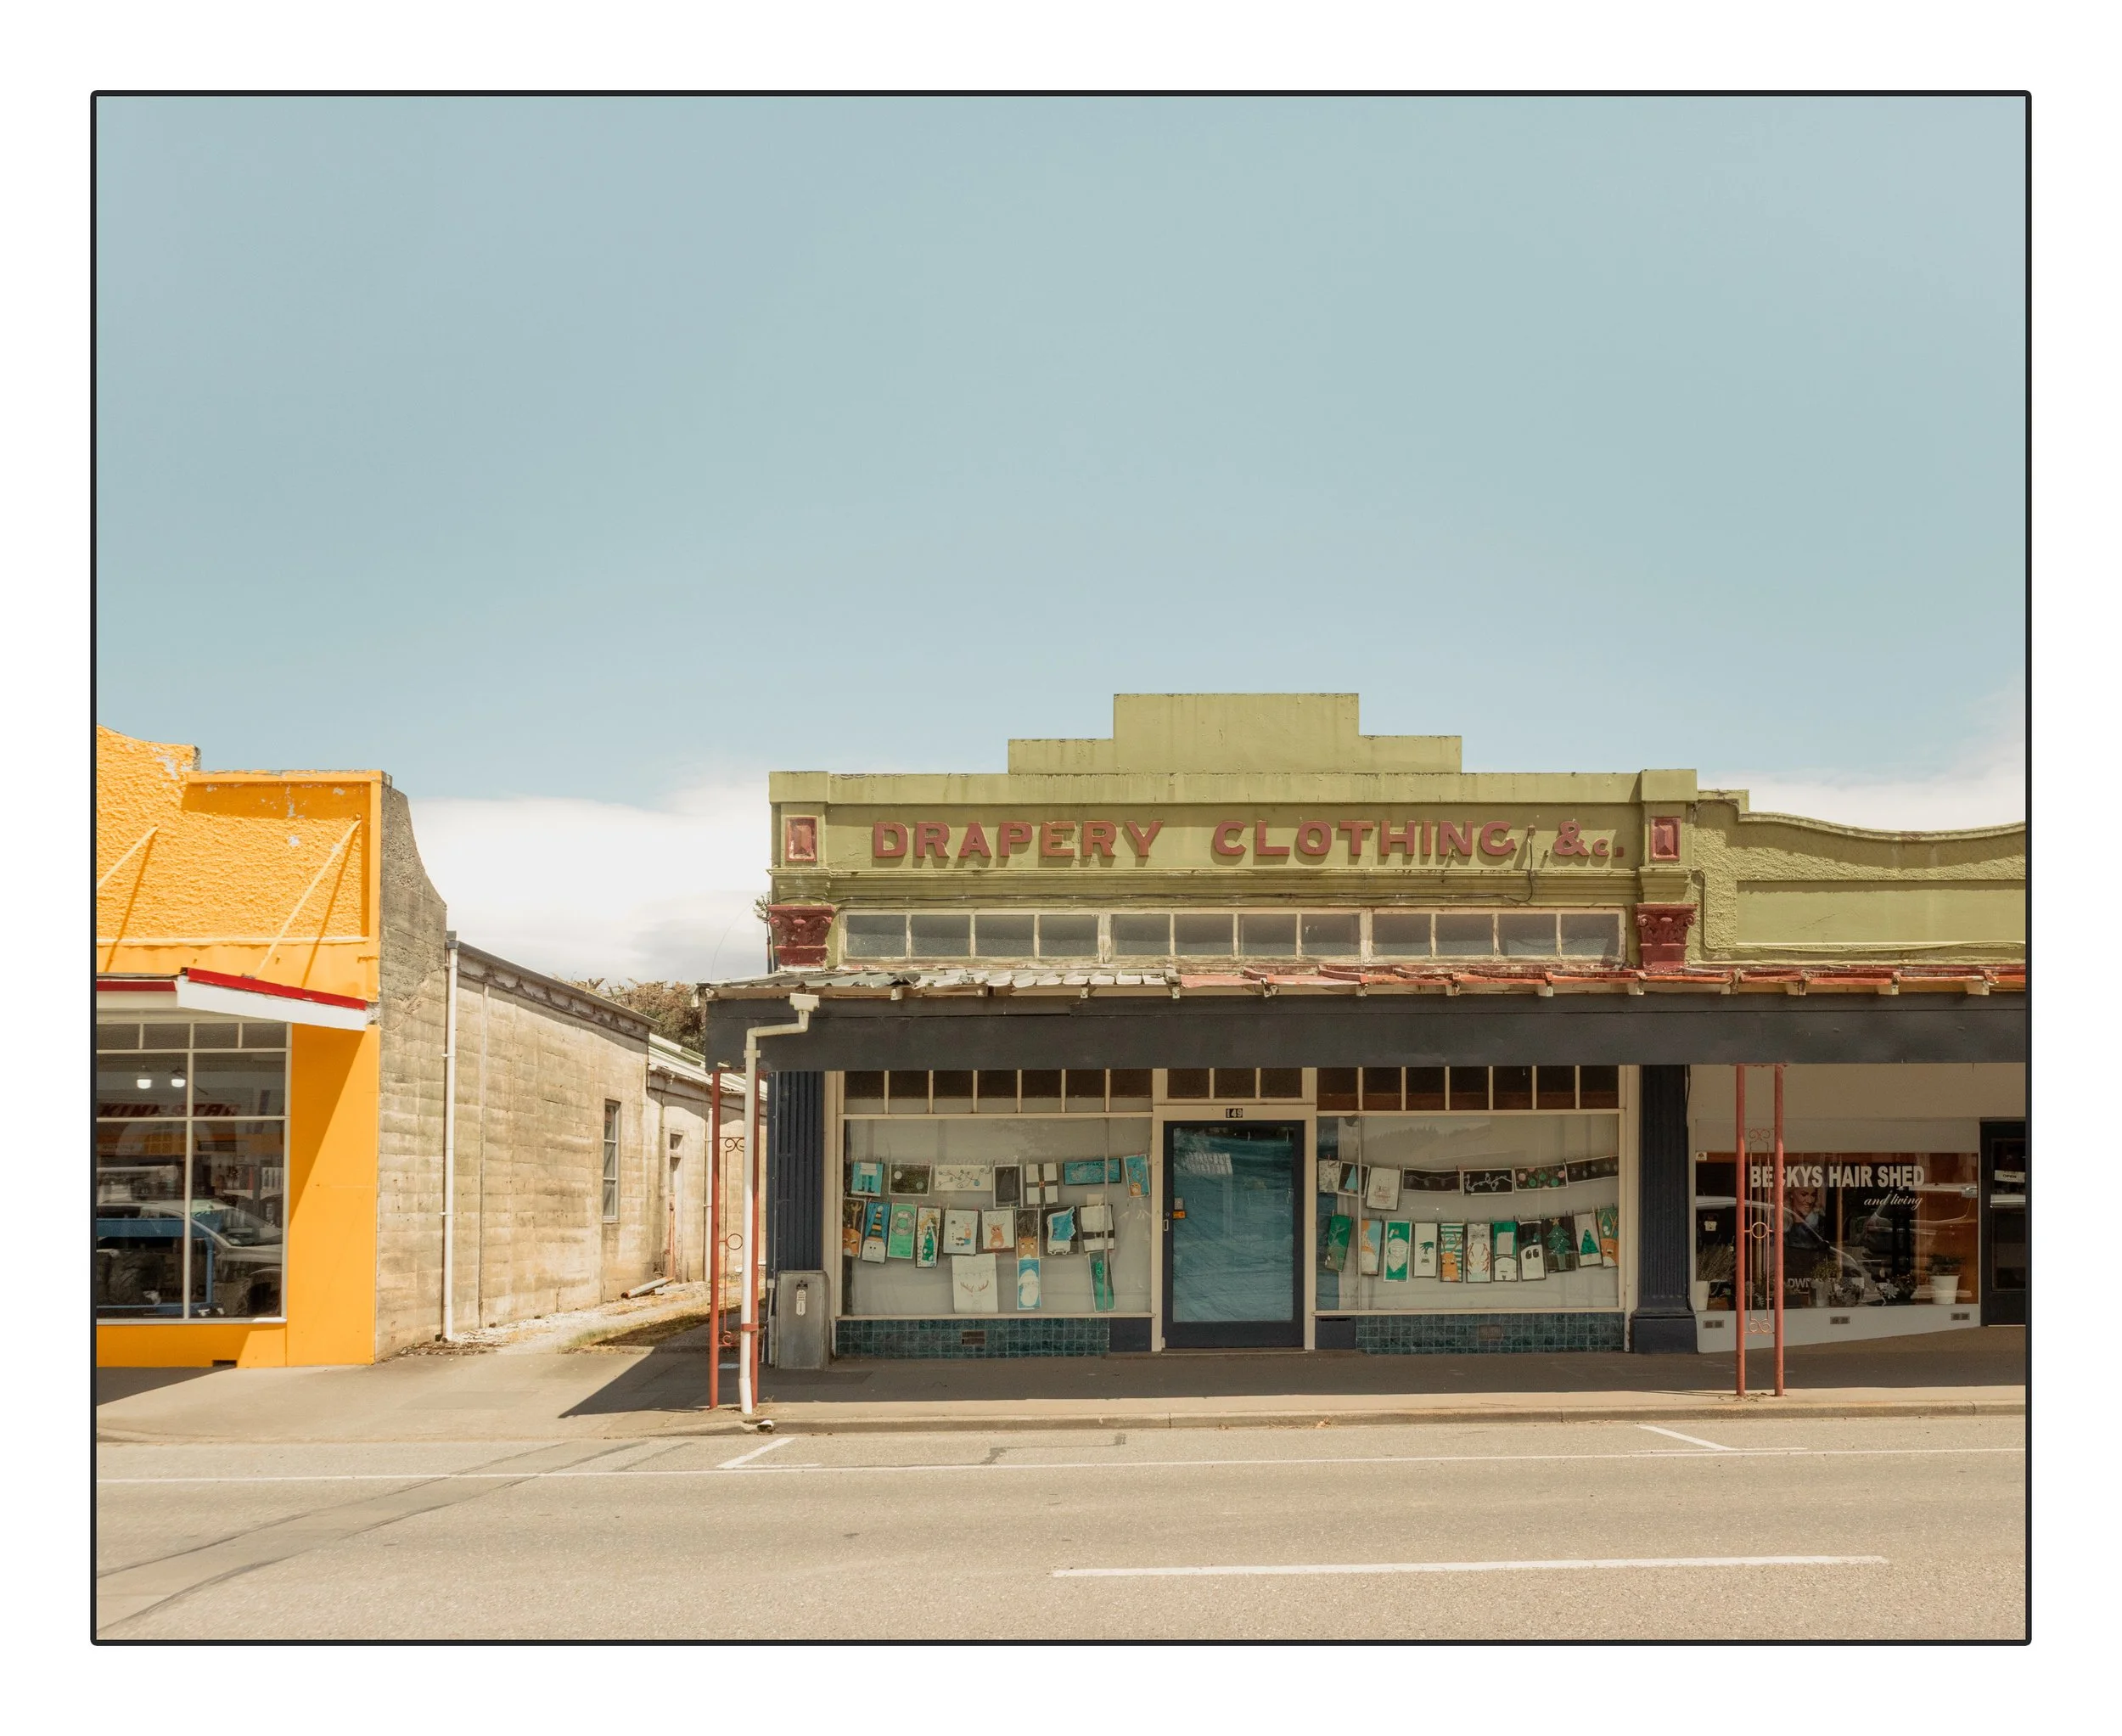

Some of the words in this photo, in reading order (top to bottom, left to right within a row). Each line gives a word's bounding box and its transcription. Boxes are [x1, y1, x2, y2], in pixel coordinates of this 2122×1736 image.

[873, 820, 1164, 857] DRAPERY
[1214, 820, 1517, 857] CLOTHING
[1227, 1109, 1243, 1118] 149
[1828, 1166, 1872, 1188] HAIR
[1878, 1166, 1925, 1188] SHED
[1863, 1193, 1888, 1206] and
[1889, 1193, 1923, 1211] living
